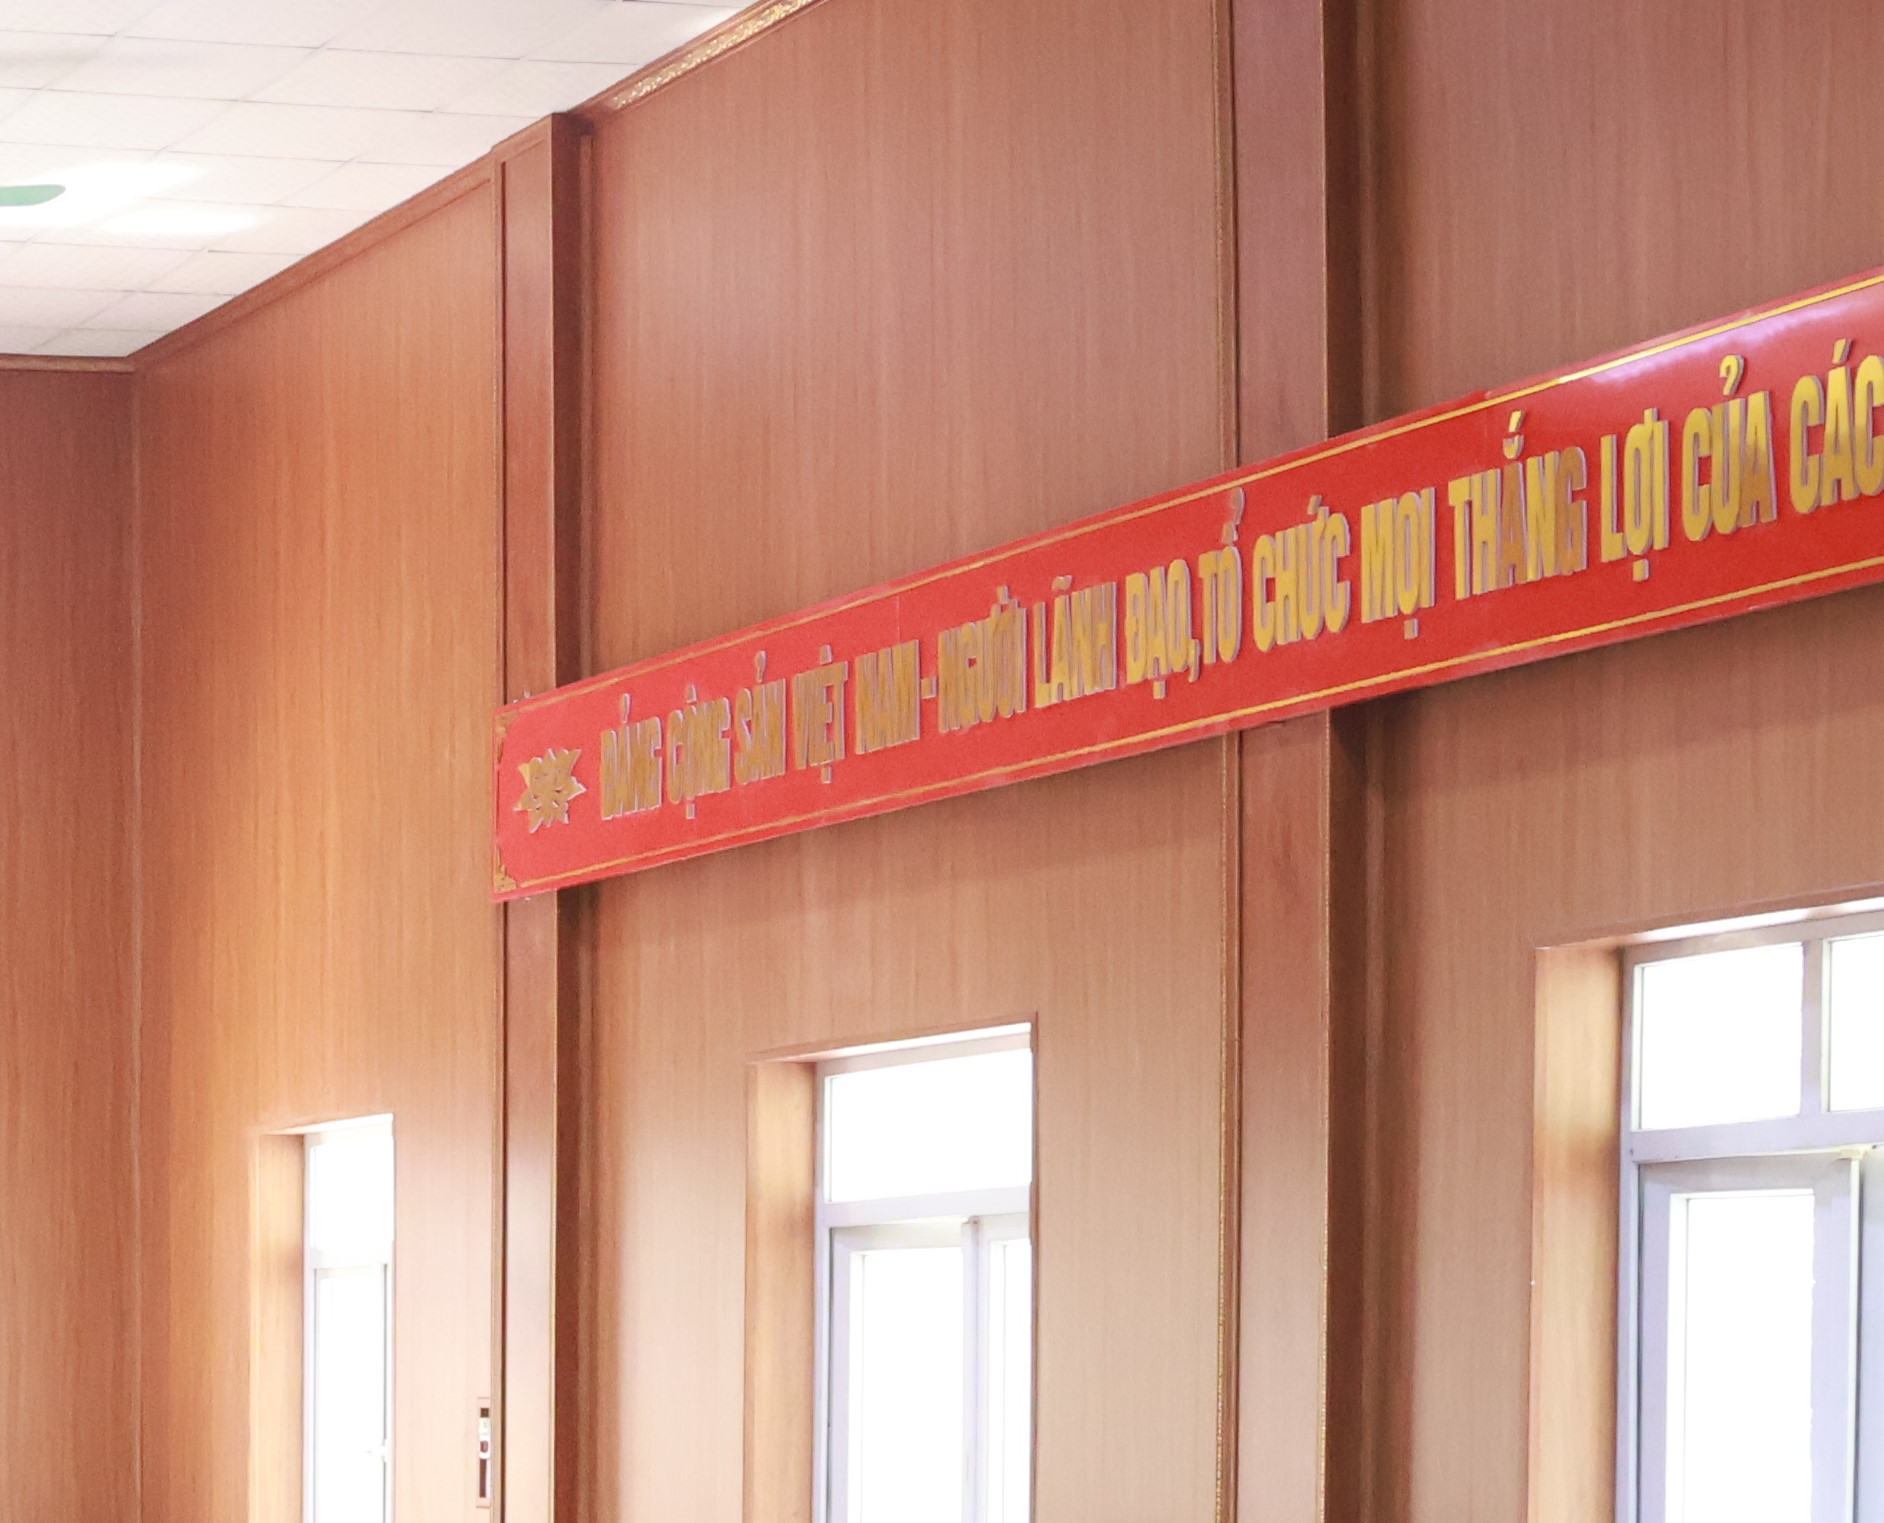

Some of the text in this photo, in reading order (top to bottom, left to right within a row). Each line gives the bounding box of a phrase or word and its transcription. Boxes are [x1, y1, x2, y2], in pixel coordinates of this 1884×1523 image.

[735, 651, 786, 785] SẢN
[792, 645, 848, 784] VIỆT
[1035, 575, 1117, 708] LÃNH
[1198, 487, 1245, 664] TỔ
[1252, 495, 1350, 653] CHỨC
[1360, 486, 1435, 639] MỌI
[1448, 411, 1587, 600] THẮNG
[1600, 407, 1669, 582] LỢI
[1682, 355, 1777, 542] CỦA
[1790, 338, 1884, 514] CÁC
